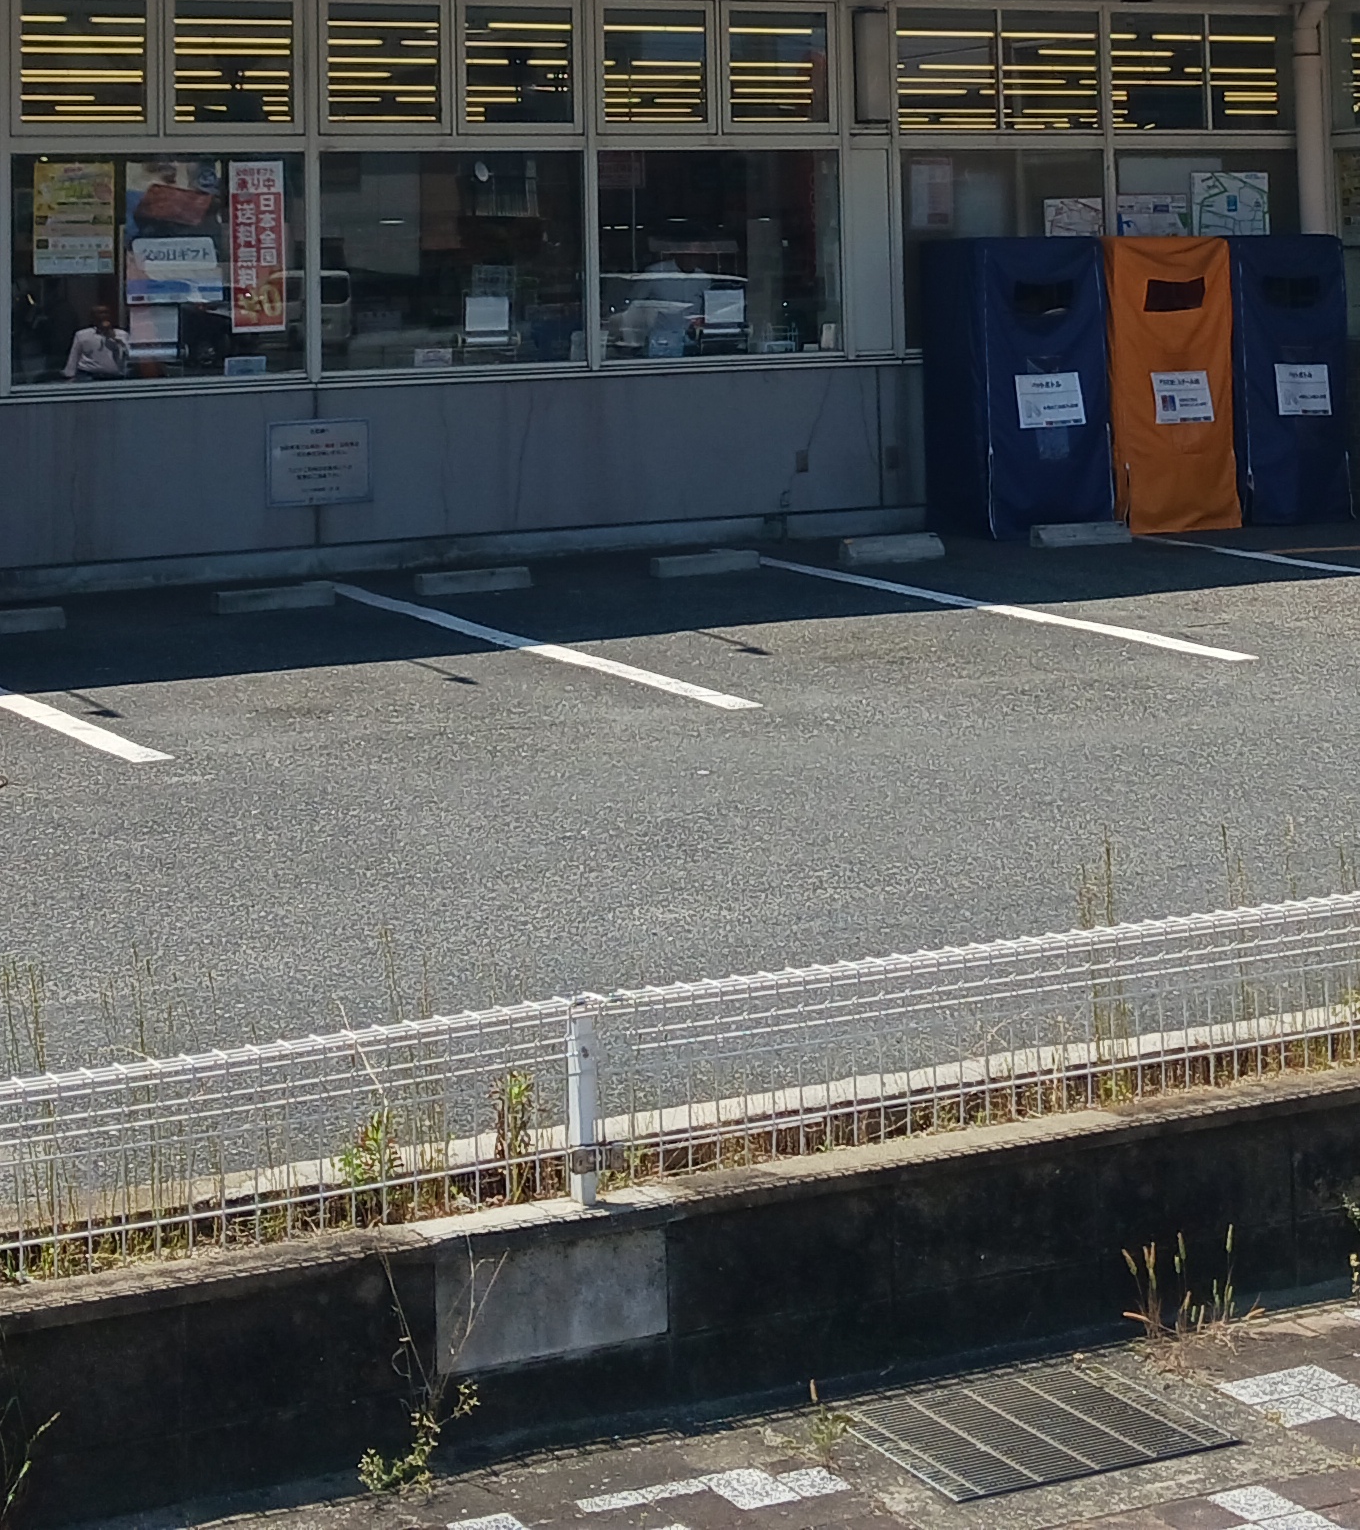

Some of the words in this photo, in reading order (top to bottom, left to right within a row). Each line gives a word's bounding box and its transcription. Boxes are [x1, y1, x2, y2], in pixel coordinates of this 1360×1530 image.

[142, 248, 209, 261] 父の日ギフト
[237, 202, 257, 288] 送料無料
[259, 194, 277, 266] 日本全国
